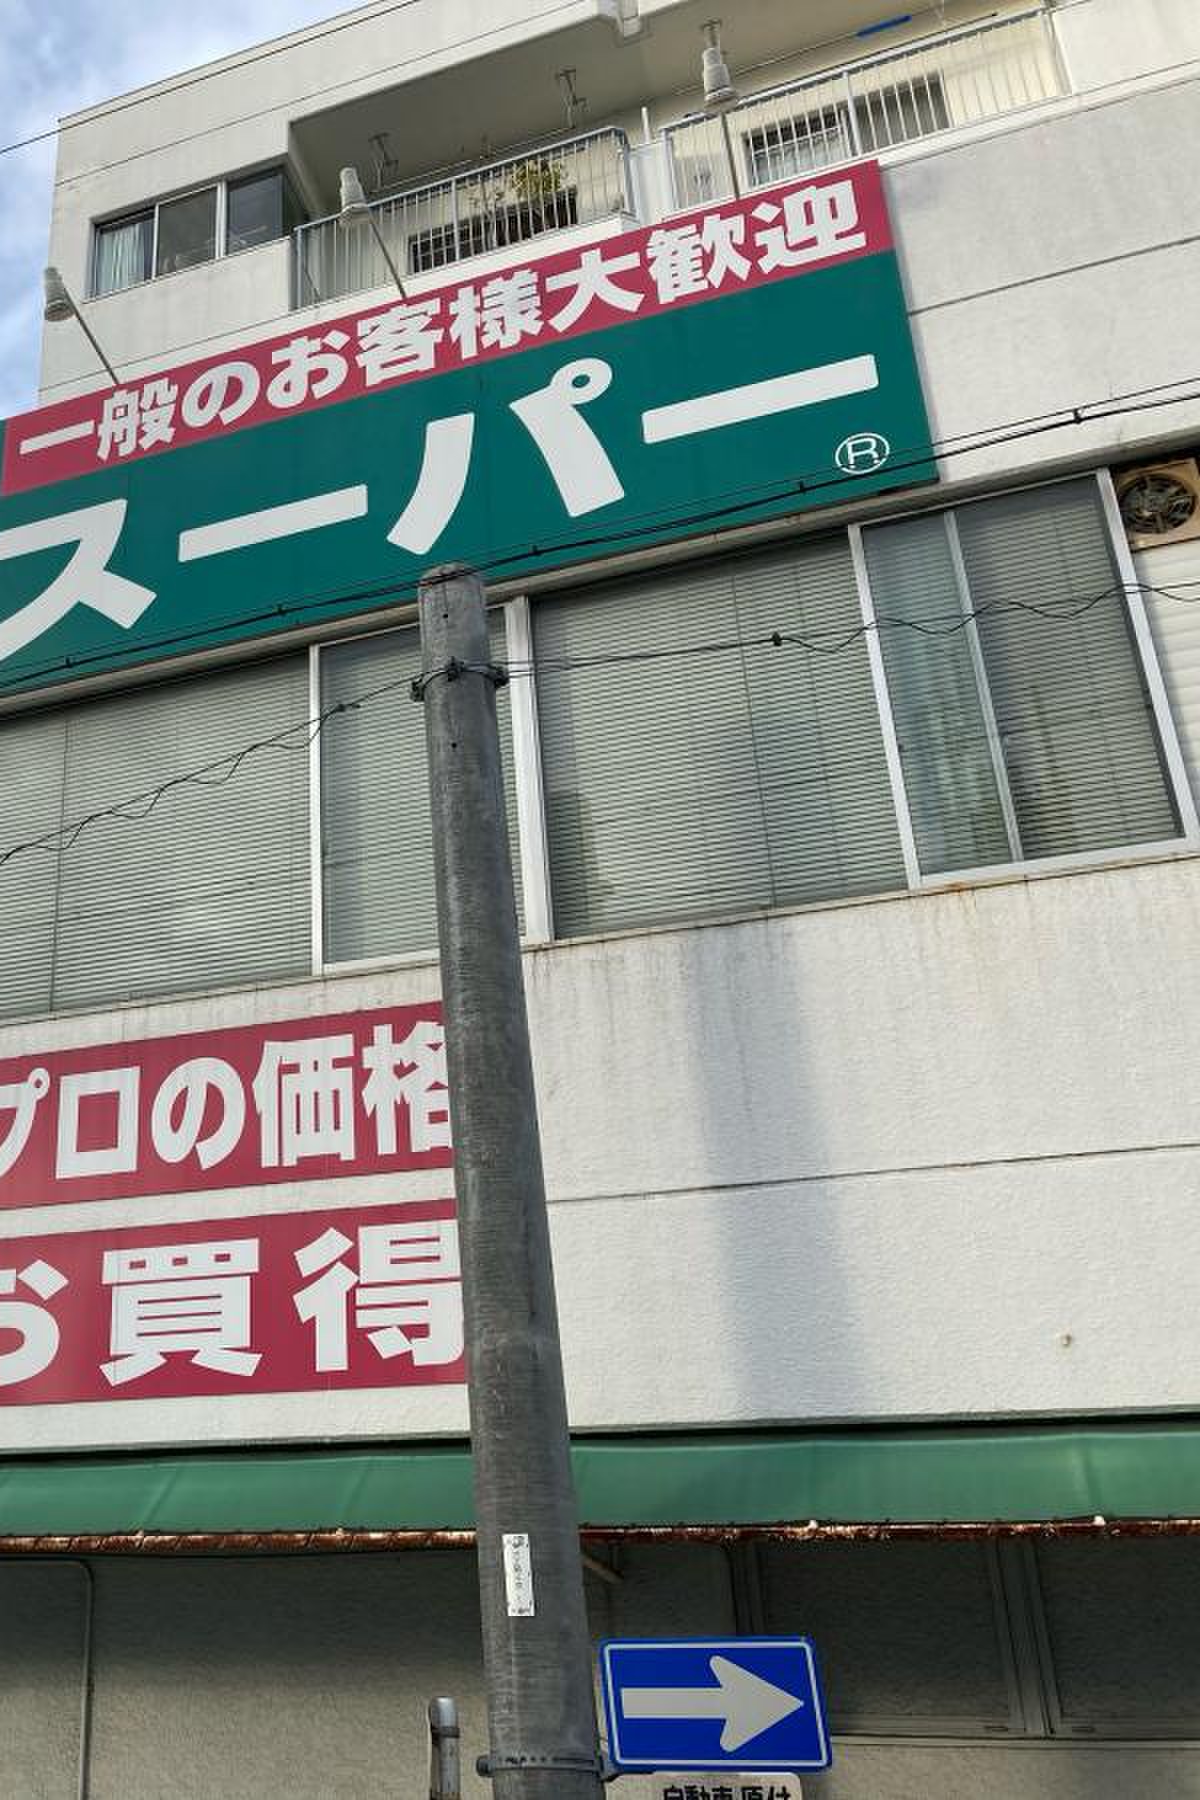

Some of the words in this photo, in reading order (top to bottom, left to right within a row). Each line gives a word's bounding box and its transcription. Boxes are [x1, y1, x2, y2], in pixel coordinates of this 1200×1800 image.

[19, 179, 866, 463] 一般のお客様大歓迎
